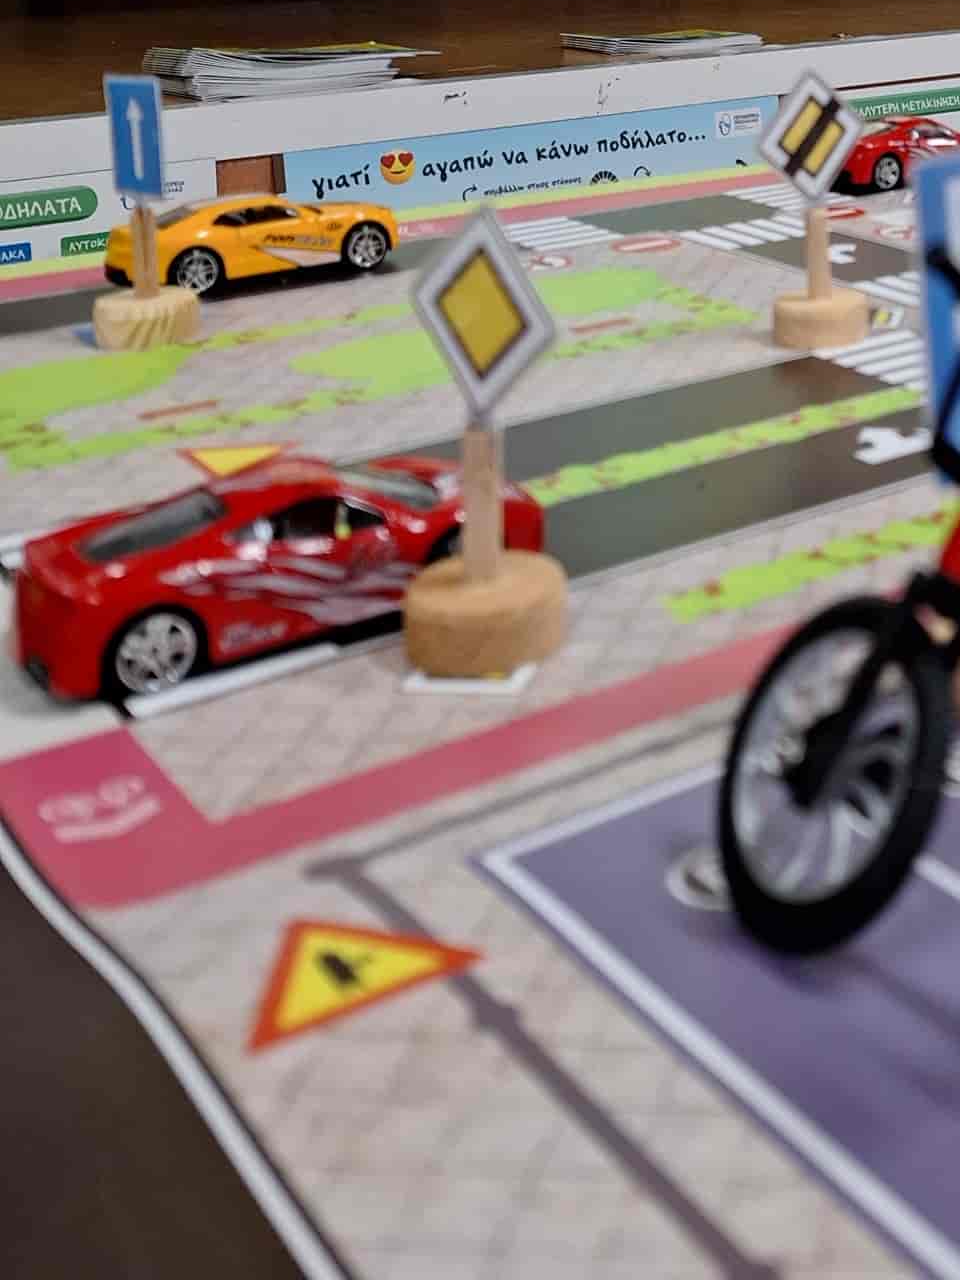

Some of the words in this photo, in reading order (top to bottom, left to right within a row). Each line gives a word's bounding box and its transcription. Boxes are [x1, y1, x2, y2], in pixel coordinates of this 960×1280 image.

[312, 164, 370, 199] γιατί
[422, 149, 493, 182] αγαπώ
[502, 150, 528, 165] να
[536, 139, 589, 161] κάνω
[598, 129, 706, 153] ποδήλατο...
[0, 196, 82, 220] ΔΗΛΑΤΑ
[69, 237, 108, 253] ΑΥΤΟΚ
